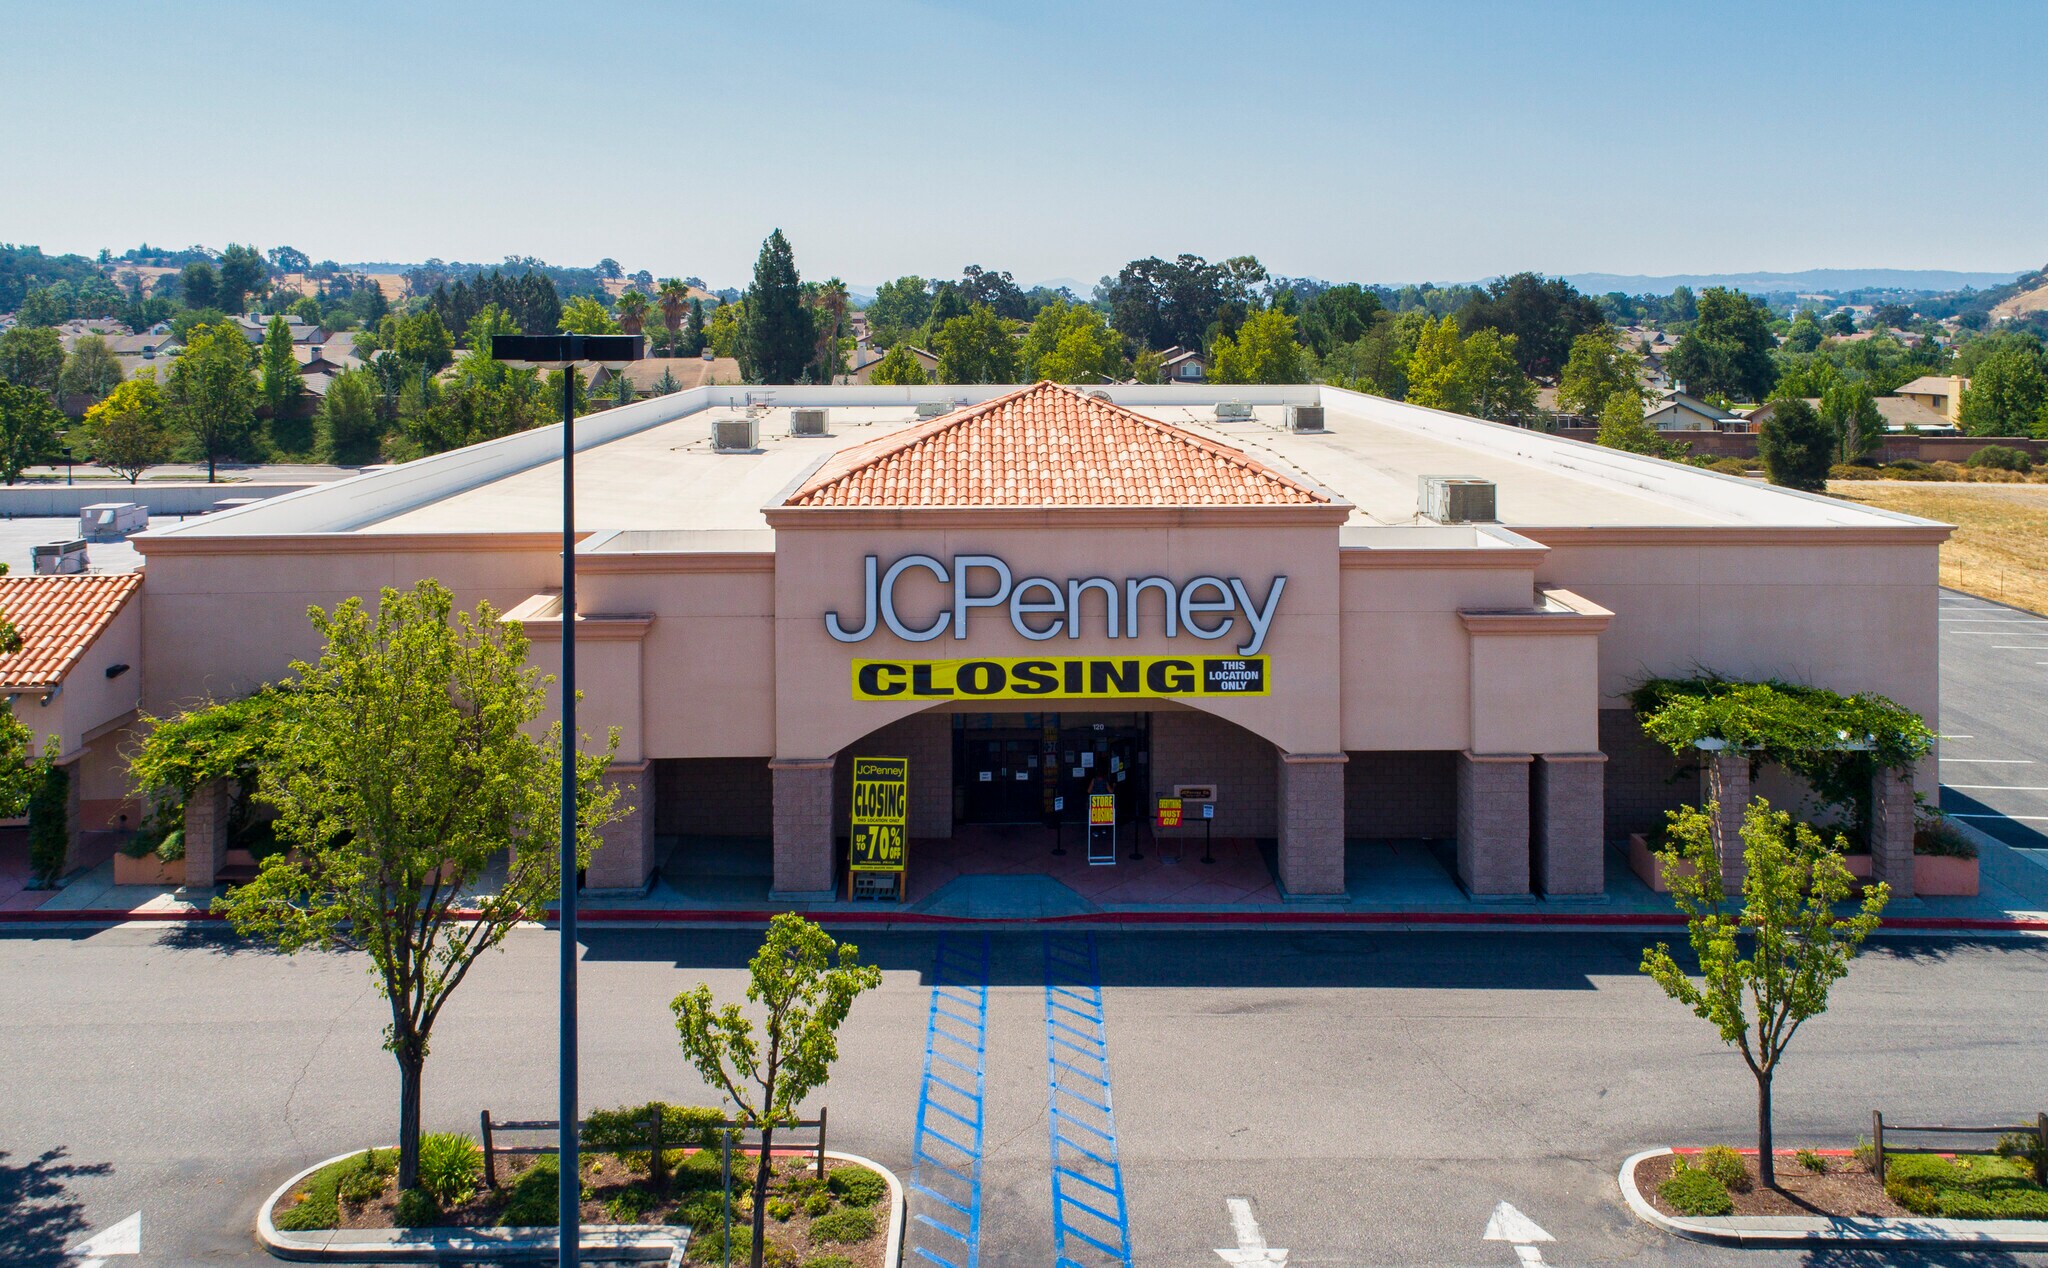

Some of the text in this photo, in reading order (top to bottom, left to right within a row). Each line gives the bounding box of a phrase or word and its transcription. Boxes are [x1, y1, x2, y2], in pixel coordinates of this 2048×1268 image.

[825, 554, 1287, 656] JCPenney
[1222, 661, 1246, 670] THIS
[858, 660, 1196, 695] CLOSING
[1209, 671, 1259, 680] LOCATION
[1221, 681, 1247, 690] ONLY
[1093, 723, 1105, 731] 120
[857, 765, 904, 777] JCPenney
[854, 783, 905, 818] CLOSING
[1091, 795, 1113, 807] STORE
[1158, 799, 1182, 809] EVERYTHING
[1091, 807, 1113, 822] CLOSING
[1160, 810, 1181, 818] MUST
[856, 834, 866, 843] UP
[856, 842, 900, 859] TO OFF
